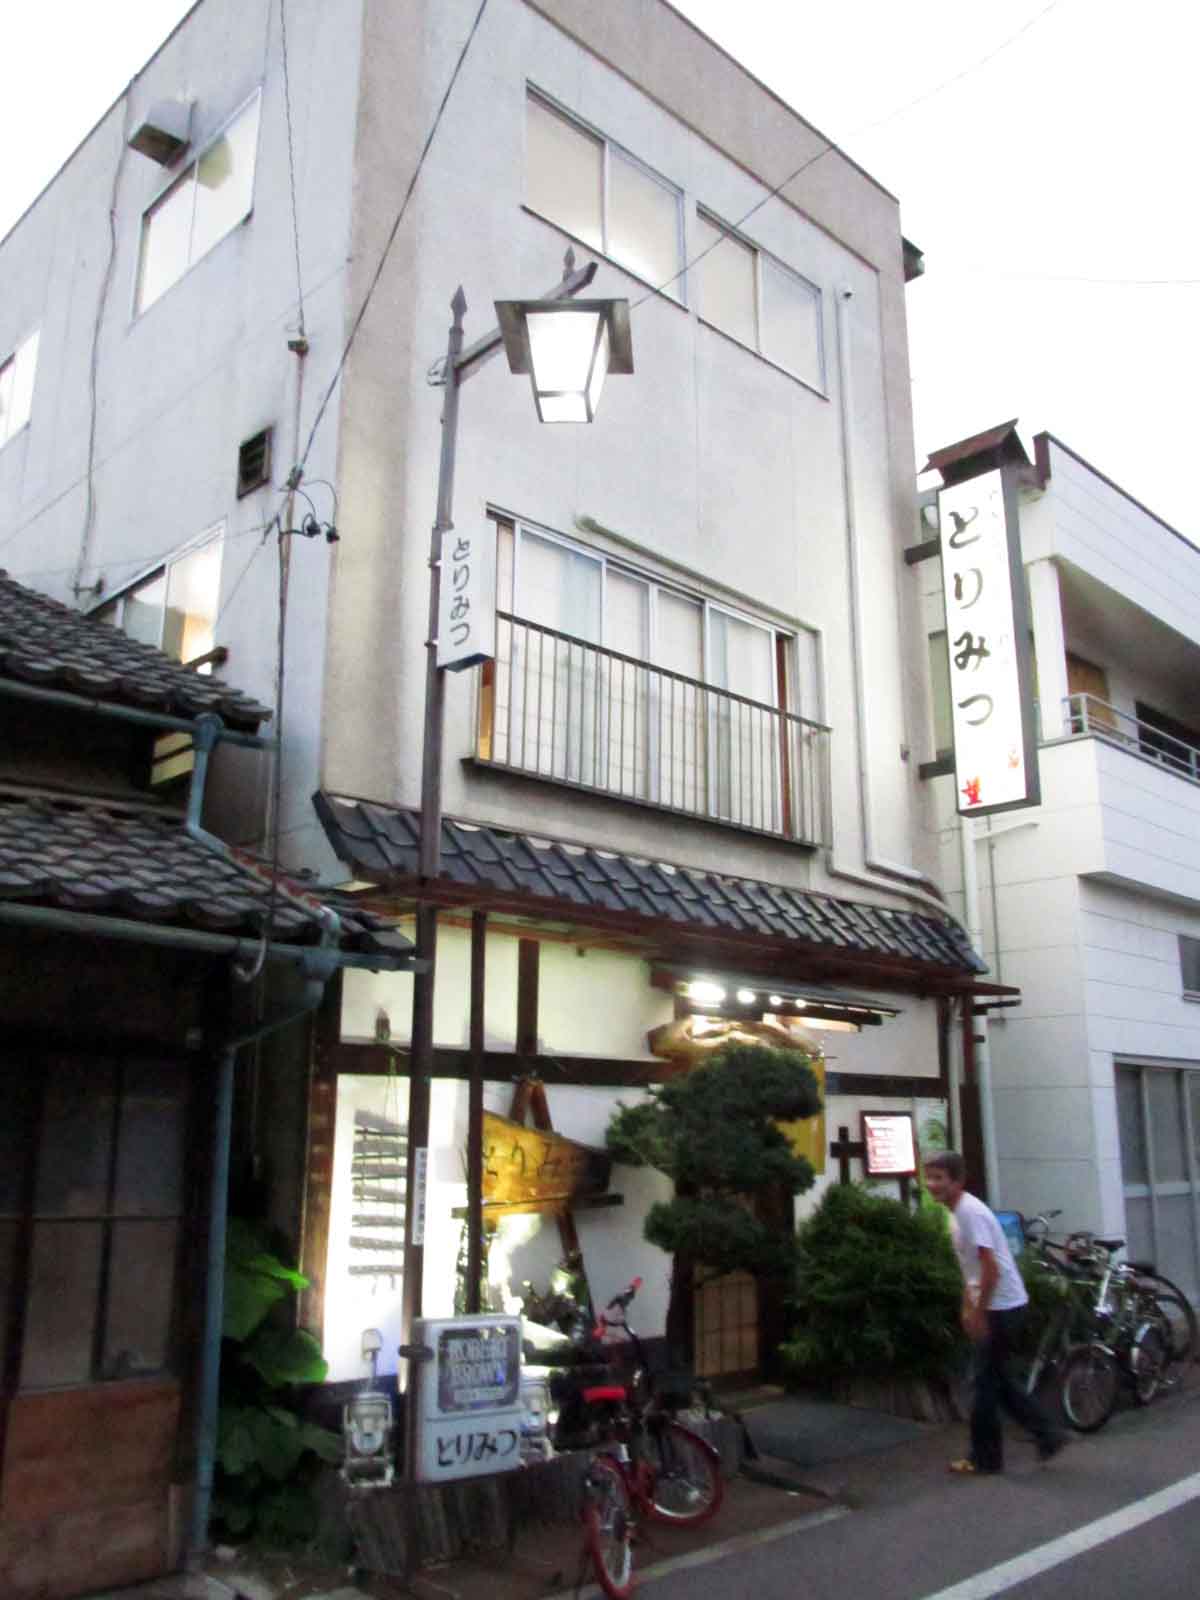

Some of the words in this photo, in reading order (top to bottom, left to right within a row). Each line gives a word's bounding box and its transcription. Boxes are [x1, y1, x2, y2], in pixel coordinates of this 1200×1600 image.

[450, 537, 471, 646] とりみつ
[949, 506, 993, 727] とりみつ
[437, 1430, 518, 1467] とりみつ
